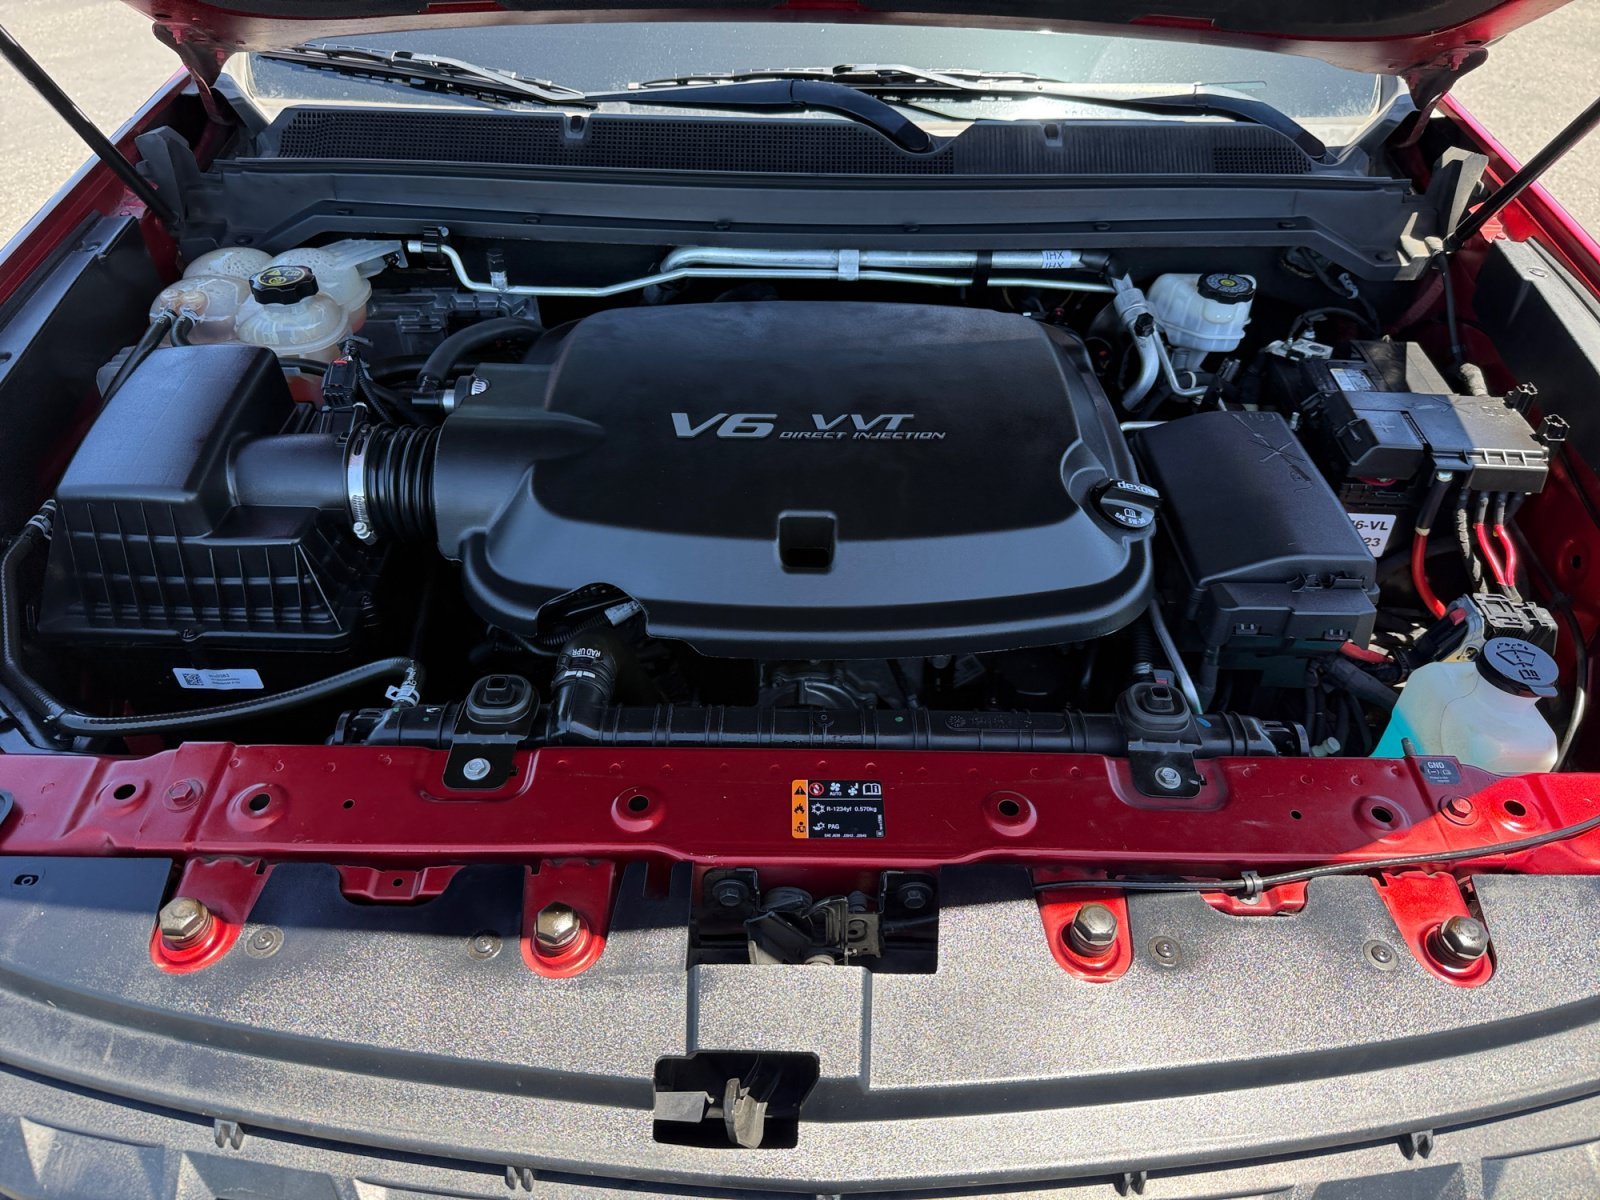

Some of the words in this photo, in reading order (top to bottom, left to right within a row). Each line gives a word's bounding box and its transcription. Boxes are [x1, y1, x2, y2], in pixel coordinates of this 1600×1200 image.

[671, 412, 778, 439] V6
[811, 413, 915, 431] VVT
[778, 431, 847, 440] DIRECT
[852, 431, 946, 440] INJECTION
[572, 647, 586, 656] UPR
[586, 648, 601, 657] RAD
[1427, 761, 1445, 769] GND
